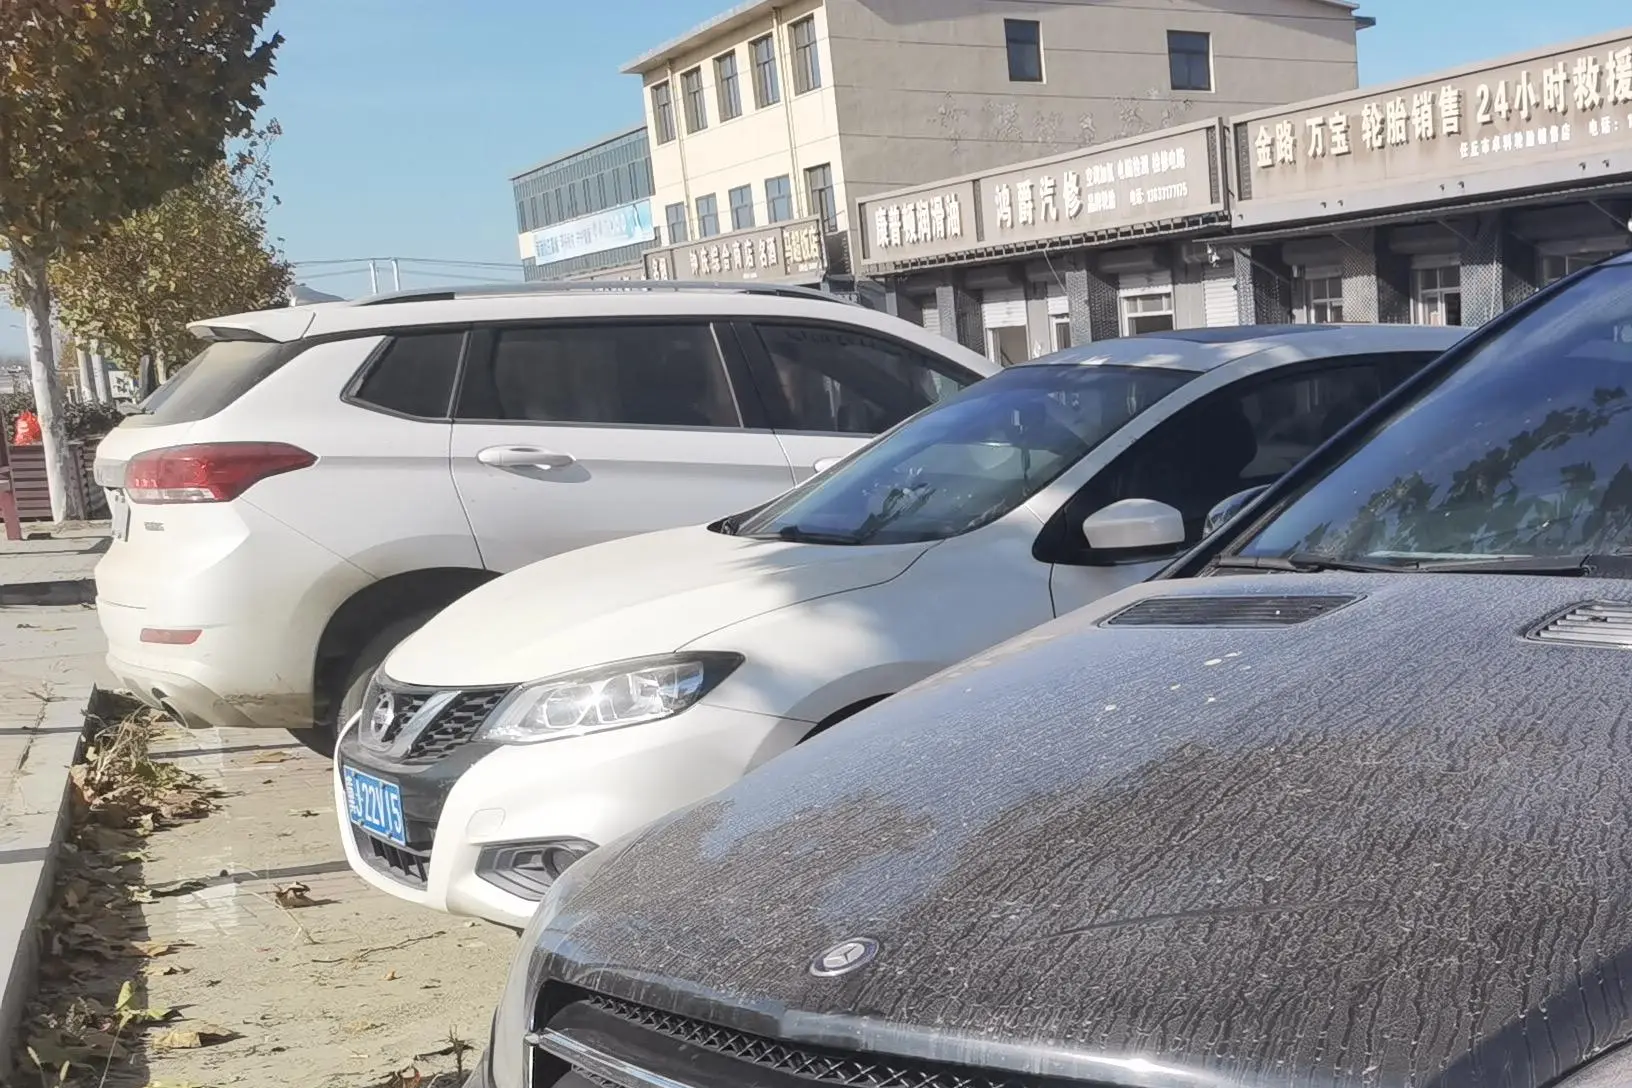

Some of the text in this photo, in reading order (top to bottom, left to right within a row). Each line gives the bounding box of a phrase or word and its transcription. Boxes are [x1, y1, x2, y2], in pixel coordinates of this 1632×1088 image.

[1254, 118, 1297, 169] 金路
[1306, 110, 1350, 158] 万宝
[1360, 84, 1465, 150] 轮胎销售
